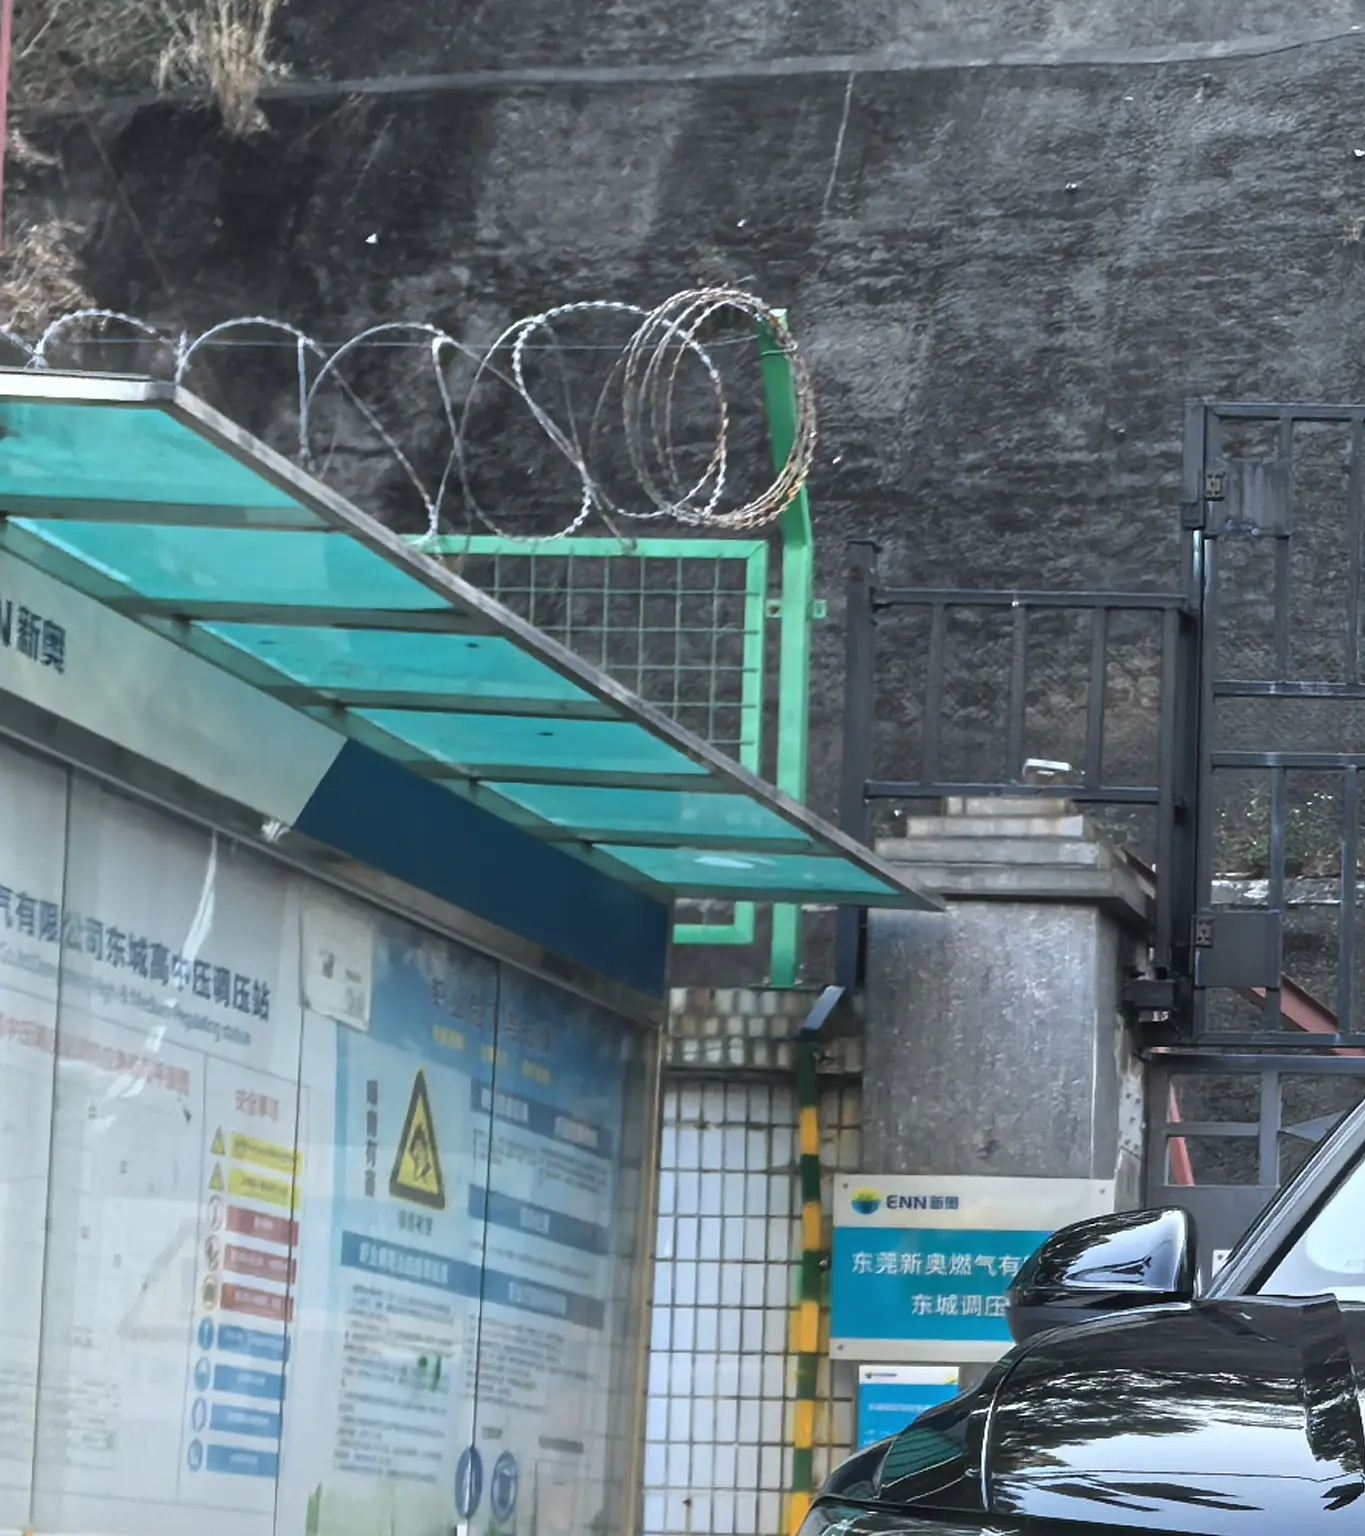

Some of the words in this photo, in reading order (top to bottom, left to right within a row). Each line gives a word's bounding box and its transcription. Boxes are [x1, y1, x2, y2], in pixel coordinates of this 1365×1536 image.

[851, 1251, 1031, 1277] 东莞新奥燃气有
[911, 1293, 1011, 1317] 东城调压
